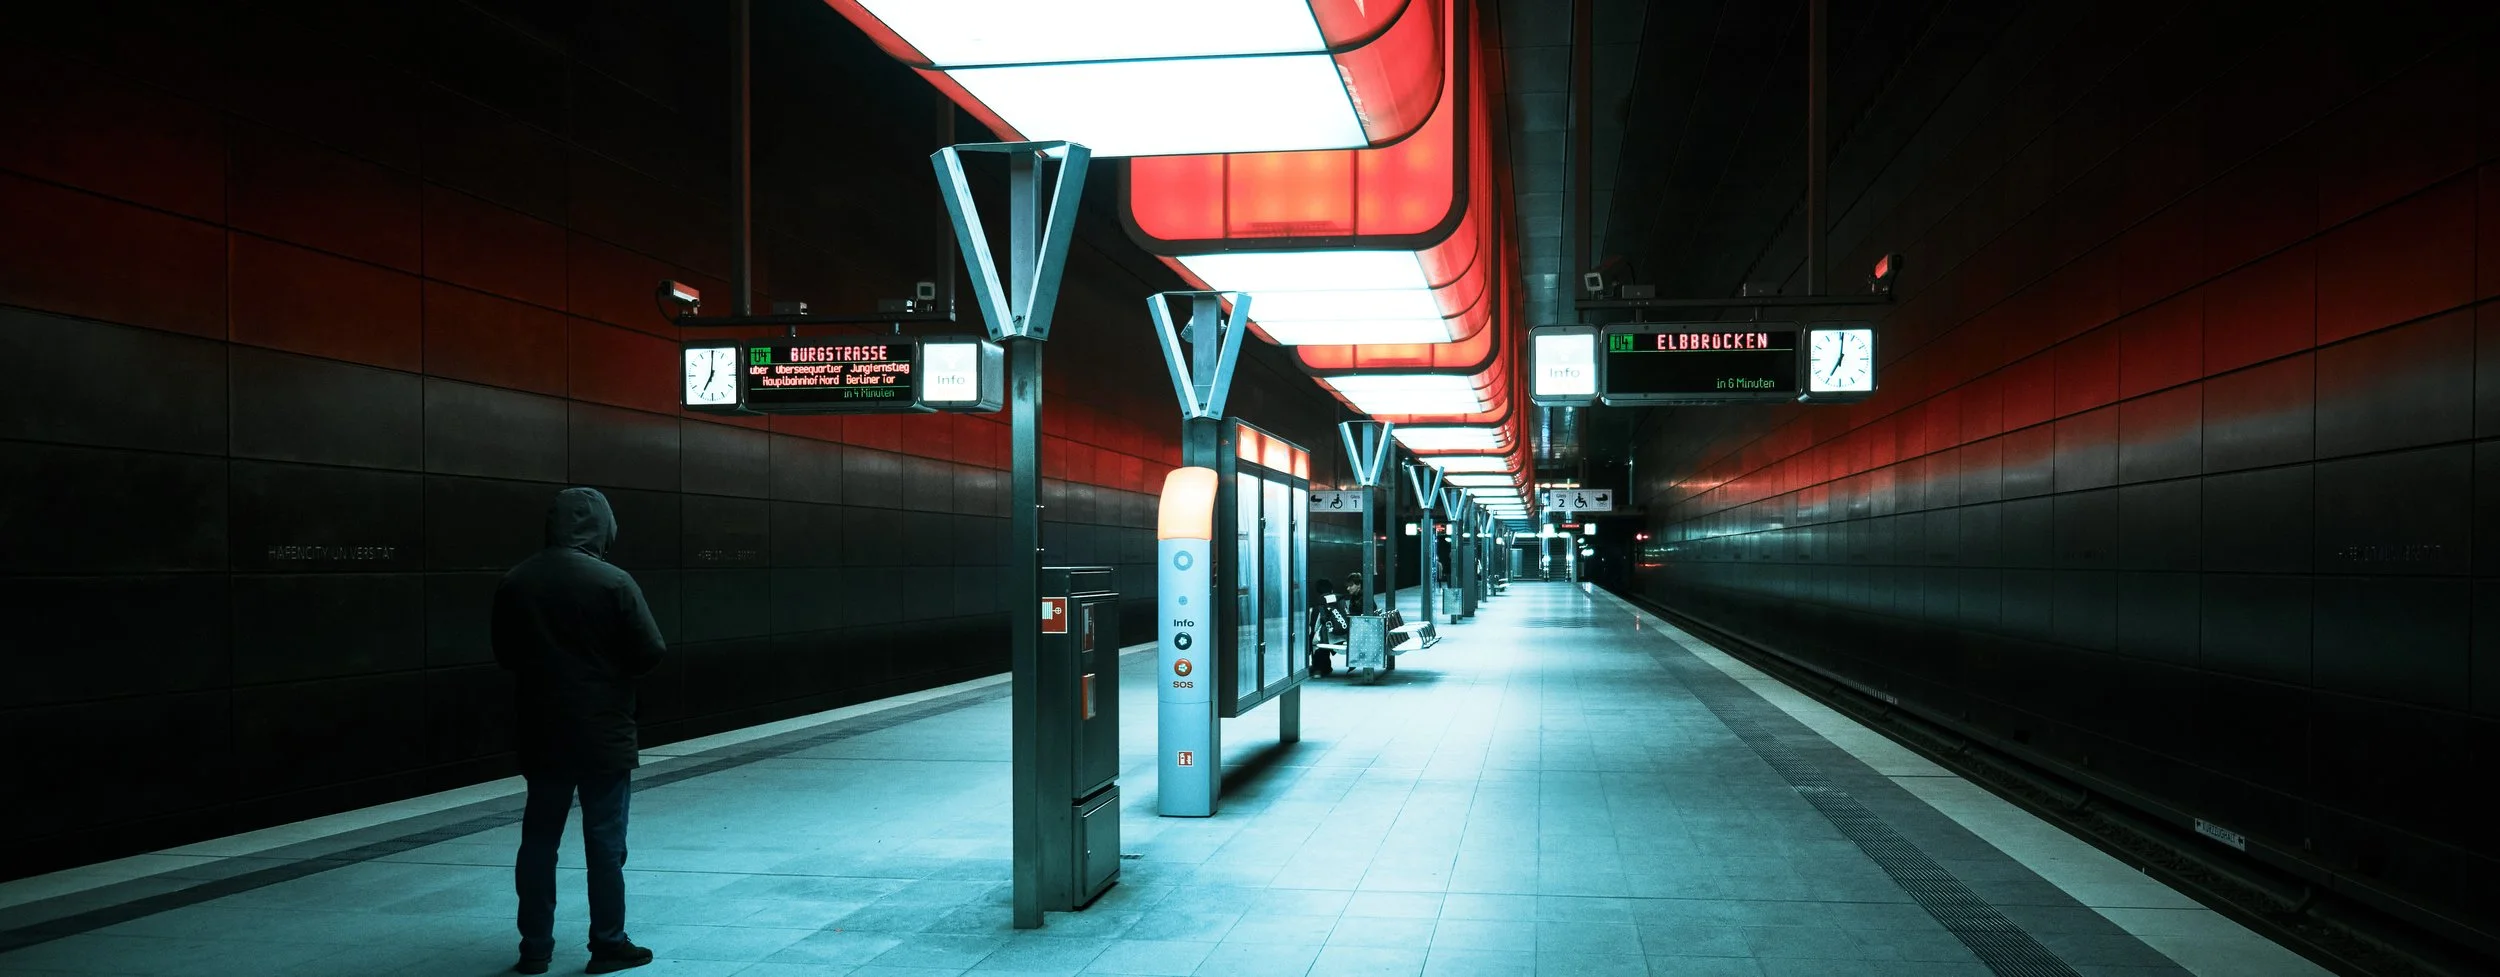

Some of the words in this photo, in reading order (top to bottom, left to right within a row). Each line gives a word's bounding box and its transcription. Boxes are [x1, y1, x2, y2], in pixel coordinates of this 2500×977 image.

[1657, 333, 1767, 350] ELBBRÜCKEN
[754, 349, 767, 362] U4
[791, 345, 887, 362] BURGSTRASSE
[1549, 367, 1580, 378] Info
[762, 374, 819, 388] Hauptbahnhof
[819, 374, 840, 385] Nord
[846, 374, 881, 385] Berliner
[882, 374, 896, 384] Tor
[937, 374, 965, 385] Info
[1717, 378, 1726, 389] in
[1728, 378, 1735, 389] 6
[1736, 377, 1775, 389] Minuten
[844, 388, 853, 398] in
[853, 388, 860, 397] 4
[861, 388, 895, 398] Minuten
[1558, 499, 1565, 508] 2
[268, 544, 328, 560] HAFENCITY
[1173, 619, 1194, 627] Info
